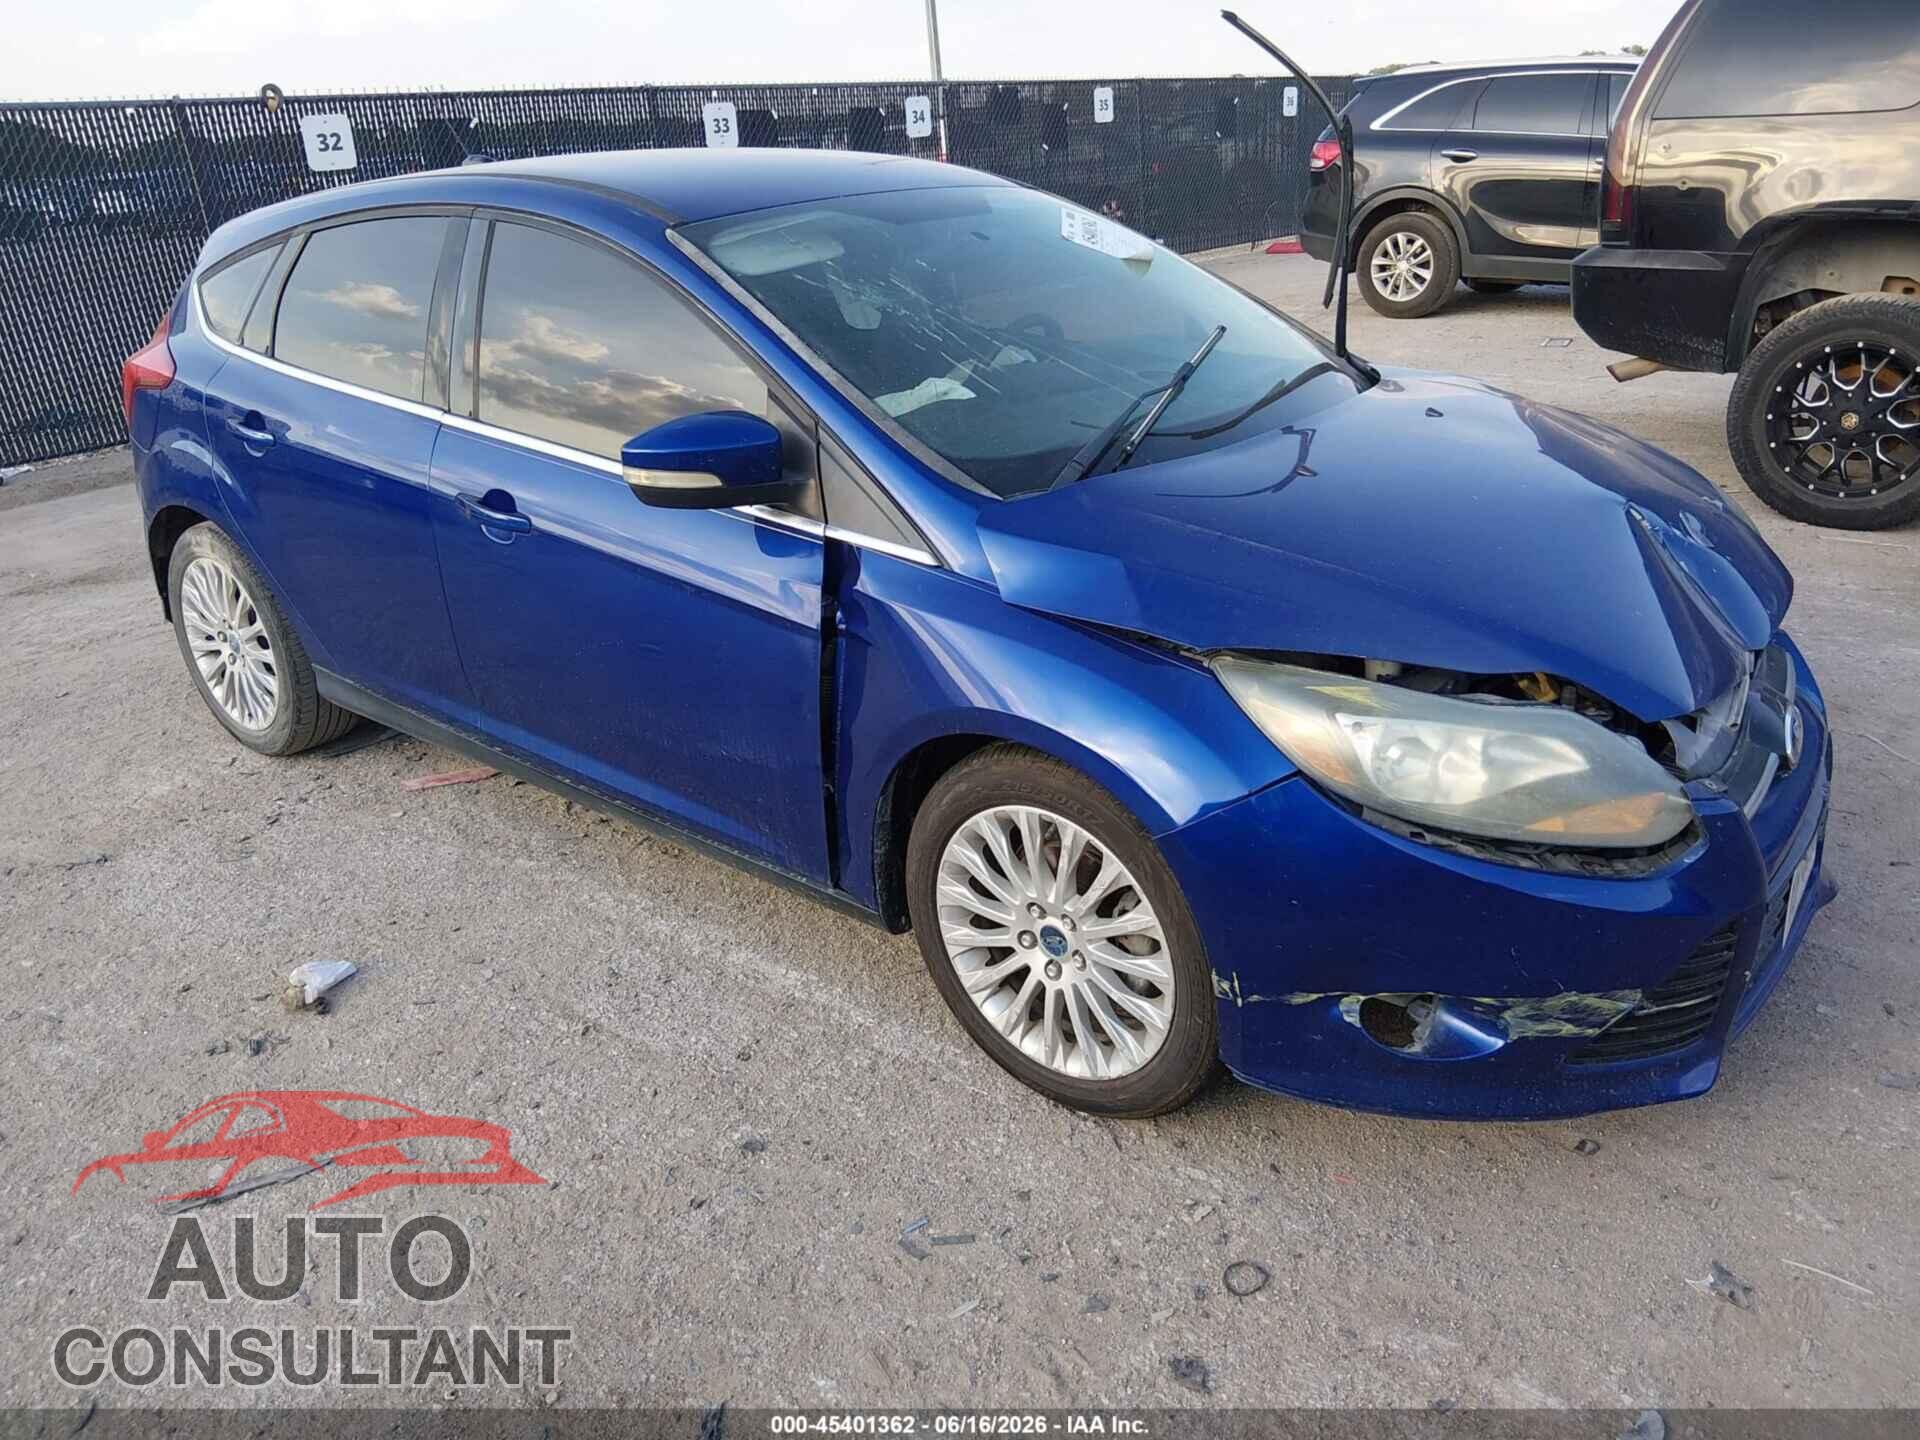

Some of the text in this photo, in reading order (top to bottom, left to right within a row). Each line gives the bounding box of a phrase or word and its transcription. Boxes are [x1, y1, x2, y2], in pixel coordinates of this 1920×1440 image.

[1099, 99, 1109, 112] 35
[712, 117, 731, 134] 33
[912, 110, 925, 125] 34
[316, 131, 345, 153] 32
